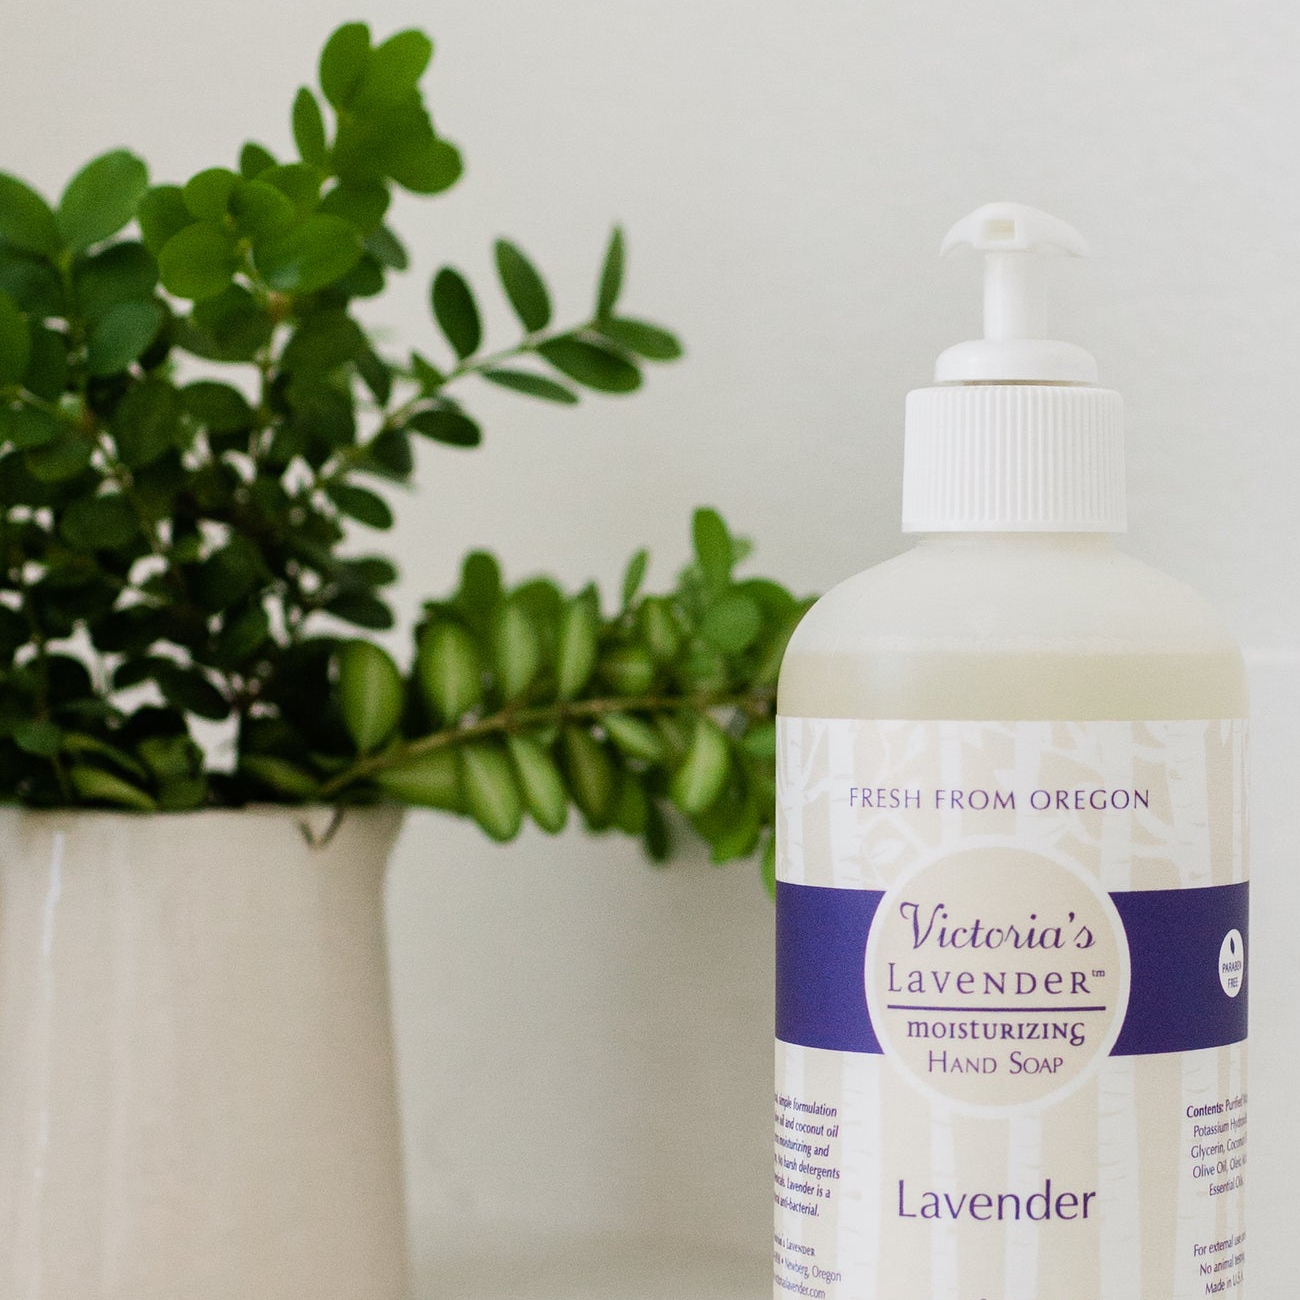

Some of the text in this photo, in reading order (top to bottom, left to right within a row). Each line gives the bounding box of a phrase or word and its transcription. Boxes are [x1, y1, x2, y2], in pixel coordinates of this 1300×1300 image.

[850, 787, 1150, 811] FRESH FROM OREGON
[899, 901, 1097, 950] Victoria's
[1227, 978, 1239, 989] FREE
[793, 1097, 838, 1117] formulation
[1186, 1102, 1223, 1119] Contents:
[795, 1122, 824, 1136] coconut
[826, 1125, 839, 1138] oil
[1193, 1121, 1230, 1138] Potassium
[814, 1144, 830, 1157] and
[1191, 1141, 1225, 1161] Glycerin,
[799, 1160, 840, 1180] detergents
[1192, 1165, 1215, 1179] Olive
[787, 1176, 815, 1195] Lavender
[816, 1184, 823, 1198] is
[825, 1189, 831, 1199] a
[1209, 1178, 1235, 1196] Essential
[898, 1178, 1097, 1221] Lavender
[1193, 1243, 1208, 1257] For
[1209, 1234, 1234, 1253] external
[812, 1265, 842, 1284] Oregon
[1199, 1263, 1212, 1277] No
[1213, 1254, 1234, 1273] animal
[1205, 1278, 1225, 1296] Made
